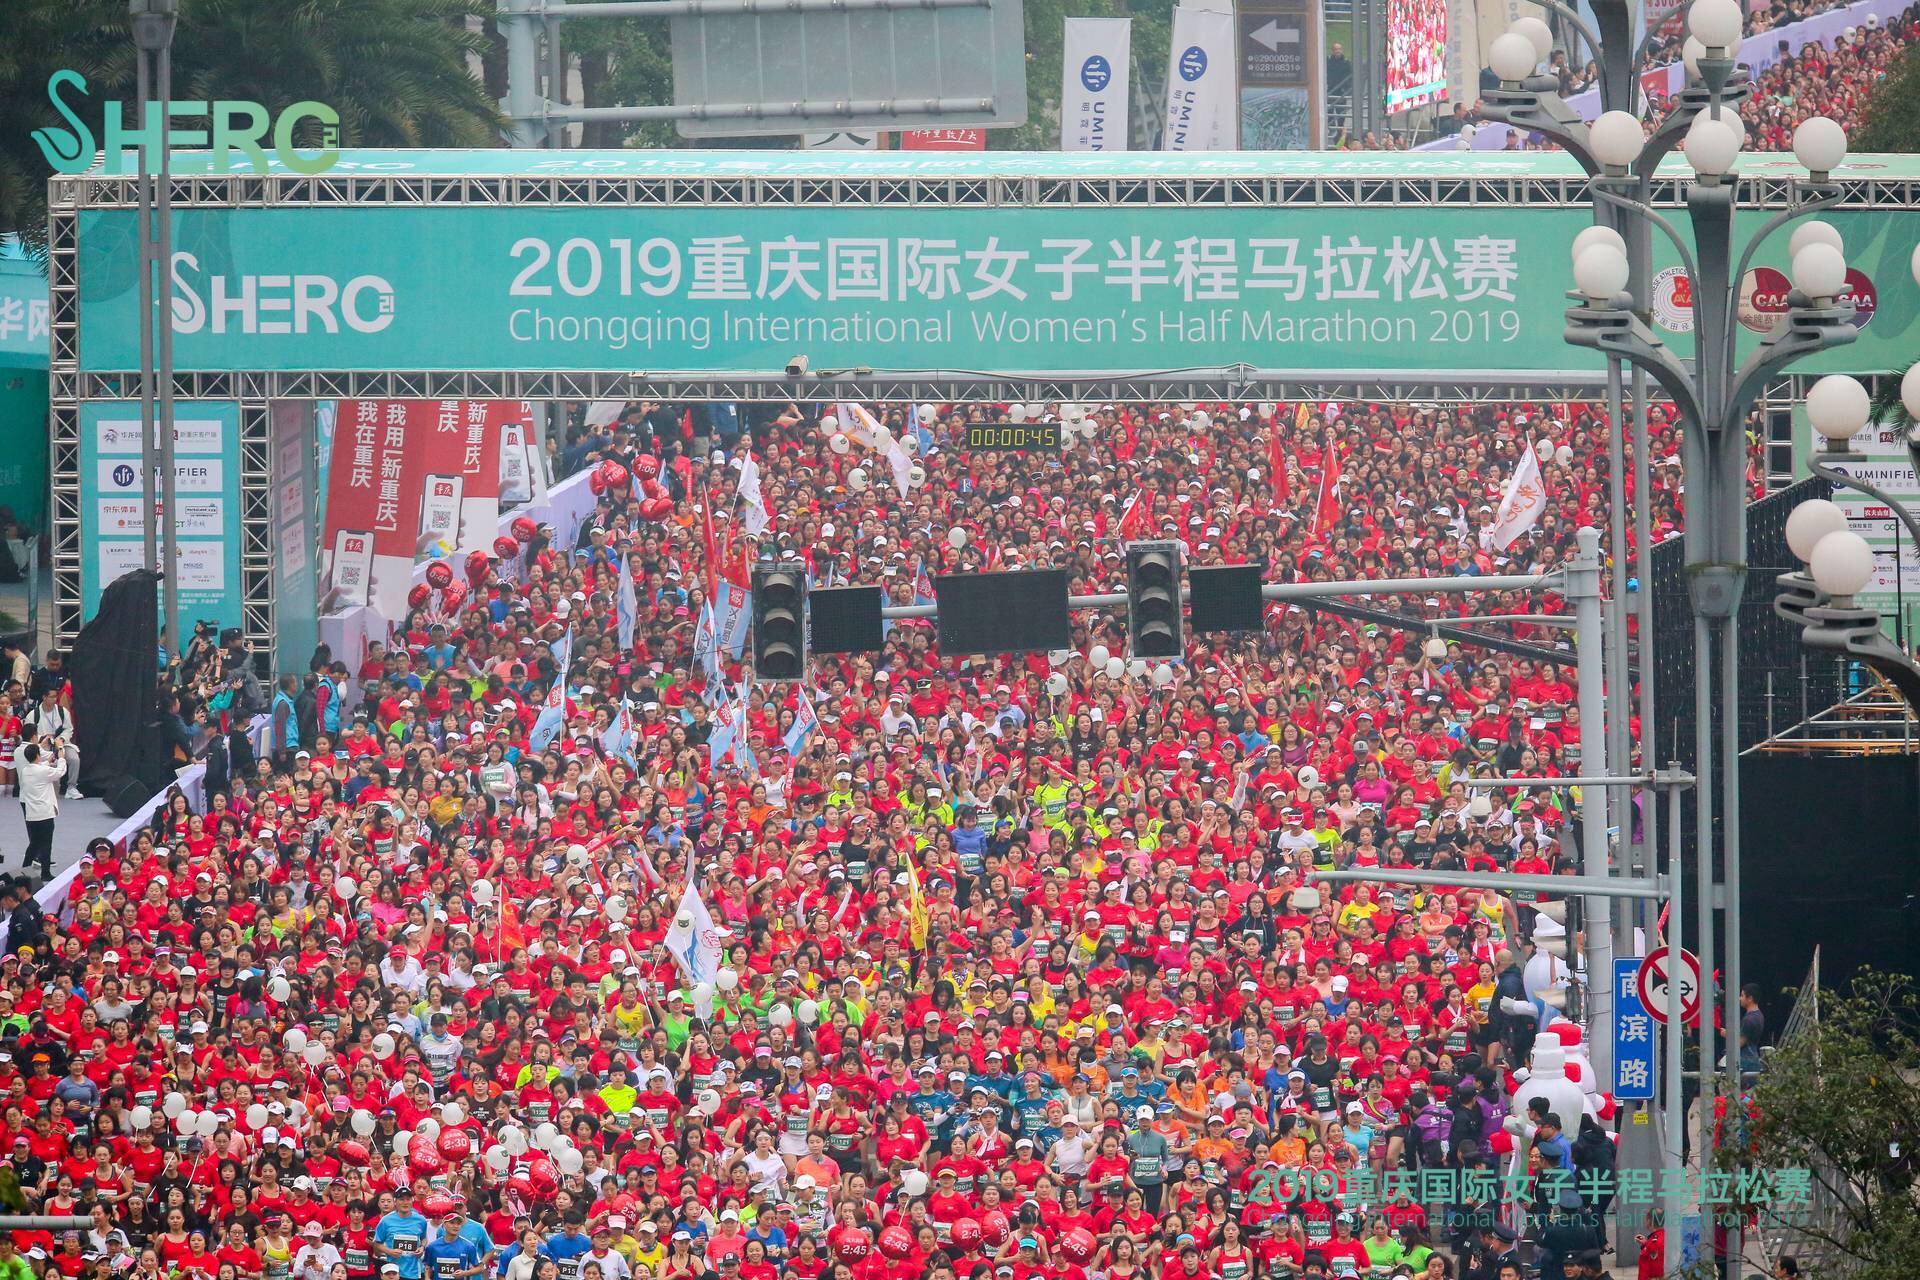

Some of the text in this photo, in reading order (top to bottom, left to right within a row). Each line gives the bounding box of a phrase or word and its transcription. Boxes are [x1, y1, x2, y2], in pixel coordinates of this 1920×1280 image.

[509, 234, 1519, 302] 2019重庆国际女子半程马拉松赛
[510, 308, 1521, 351] Chongqing International Women's Half Marathon 2019
[971, 428, 1055, 446] 00:00:45
[350, 401, 379, 489] 我在重庆
[637, 463, 656, 475] 1:00
[429, 571, 449, 584] 0:45
[443, 1138, 467, 1151] 2:30
[414, 1152, 439, 1167] 2:30
[538, 1163, 559, 1184] 2:30
[621, 1206, 637, 1220] 2:30
[398, 1242, 413, 1250] P18
[841, 1244, 867, 1255] 2:45
[883, 1236, 909, 1252] 2:45
[1062, 1236, 1087, 1257] 2:45
[562, 1267, 576, 1275] P15
